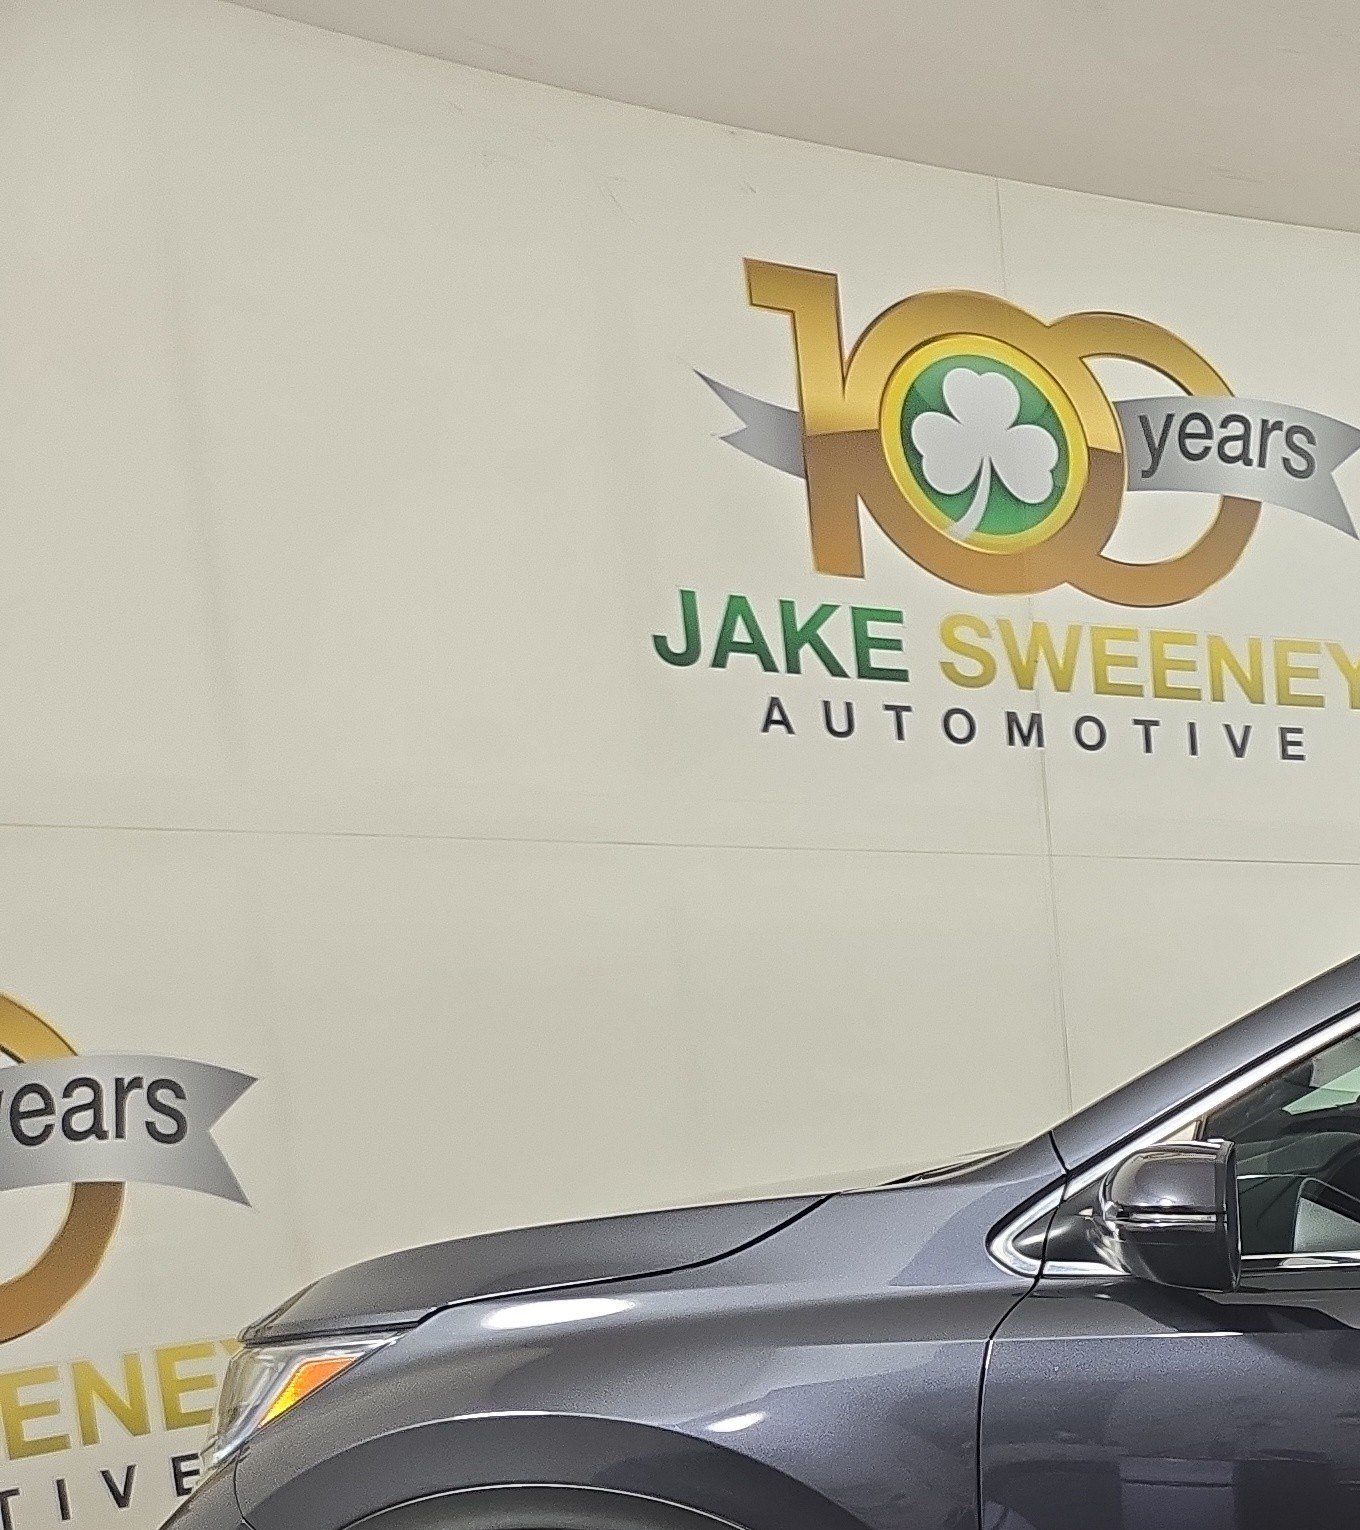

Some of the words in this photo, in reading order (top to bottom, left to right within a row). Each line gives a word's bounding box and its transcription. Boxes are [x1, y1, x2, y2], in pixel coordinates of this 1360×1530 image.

[743, 257, 1262, 608] 100
[1136, 409, 1319, 479] years
[652, 589, 911, 684] JAKE
[761, 696, 1307, 762] AUTOMOTIVE
[0, 1076, 188, 1147] ears
[0, 1338, 243, 1461] ENE
